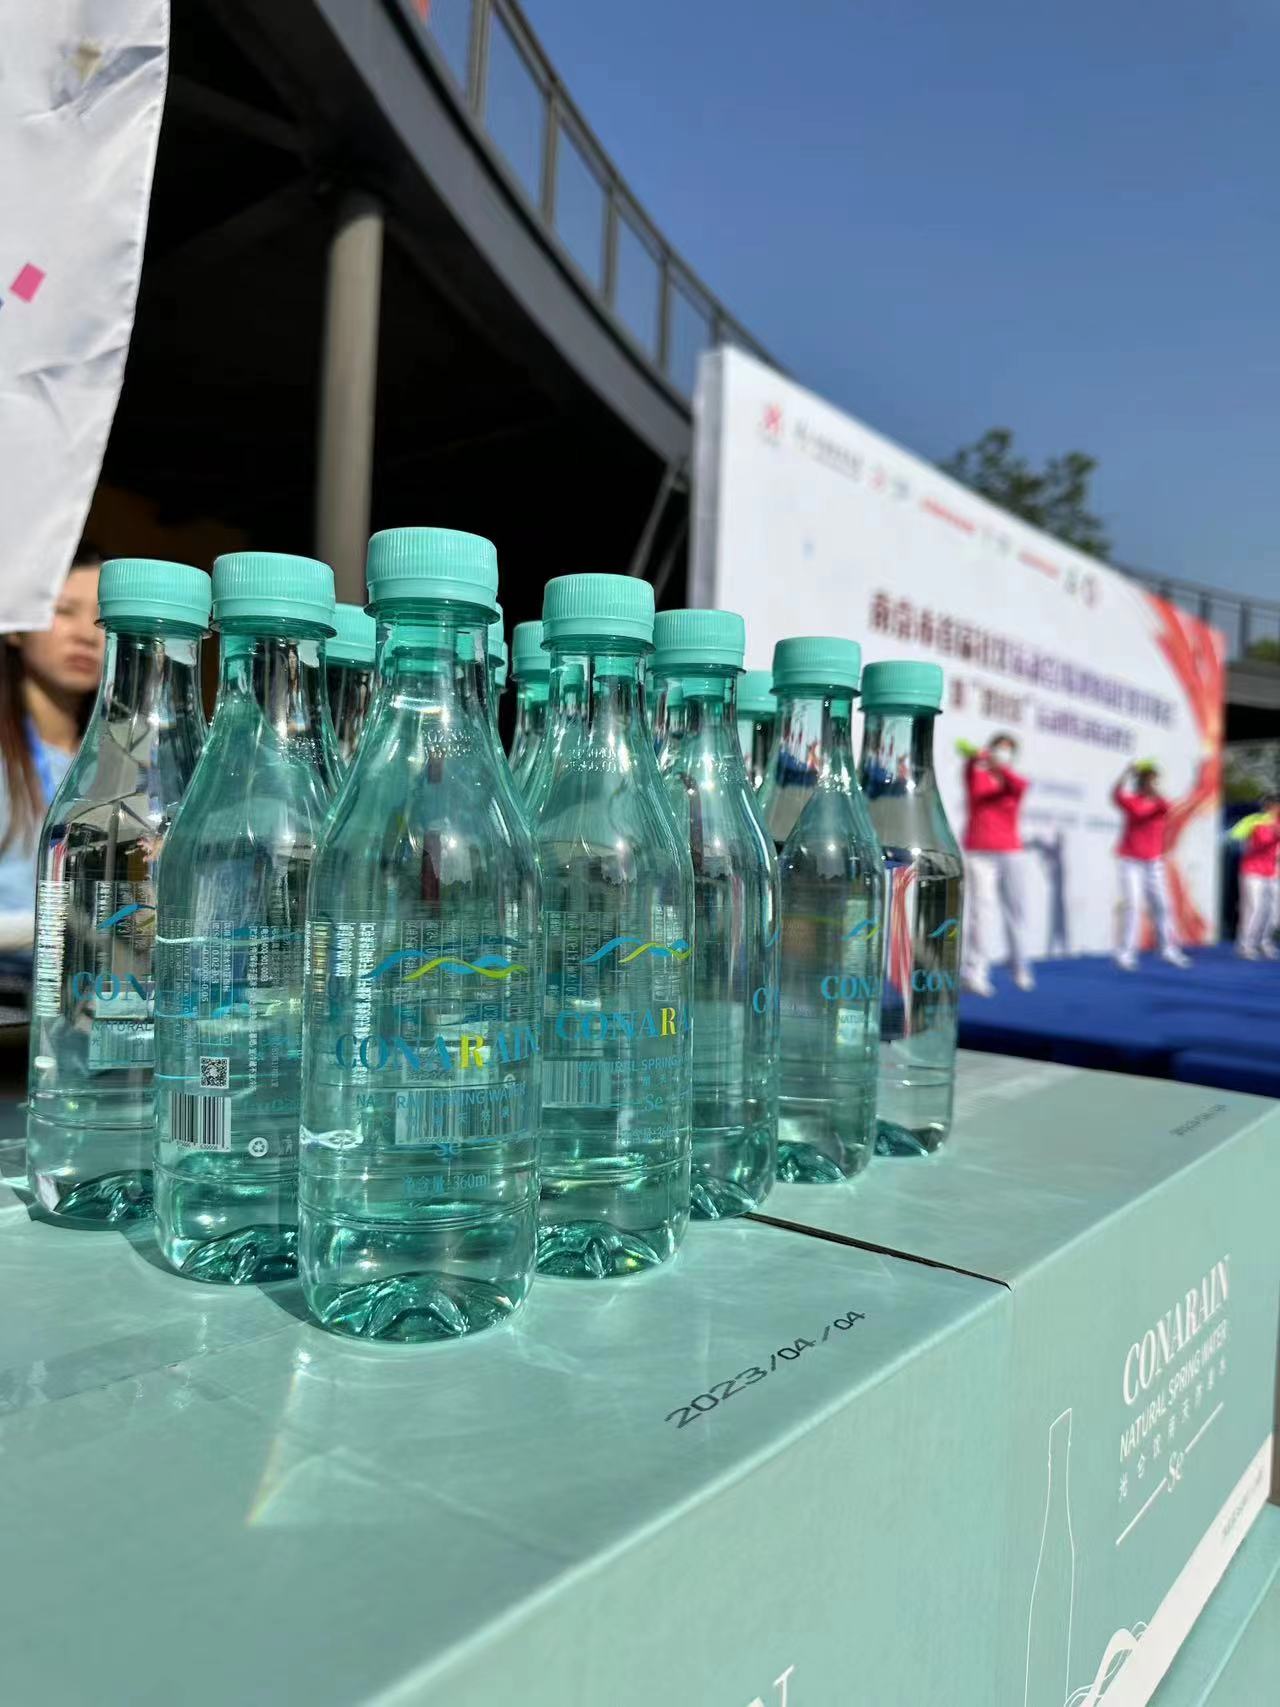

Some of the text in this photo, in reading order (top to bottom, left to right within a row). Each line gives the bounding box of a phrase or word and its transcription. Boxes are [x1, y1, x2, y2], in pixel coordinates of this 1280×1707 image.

[335, 1024, 540, 1072] CONARAIN
[1122, 1253, 1230, 1406] CONARAIN
[1120, 1390, 1166, 1462] NATURAL
[1168, 1352, 1200, 1405] SPRING
